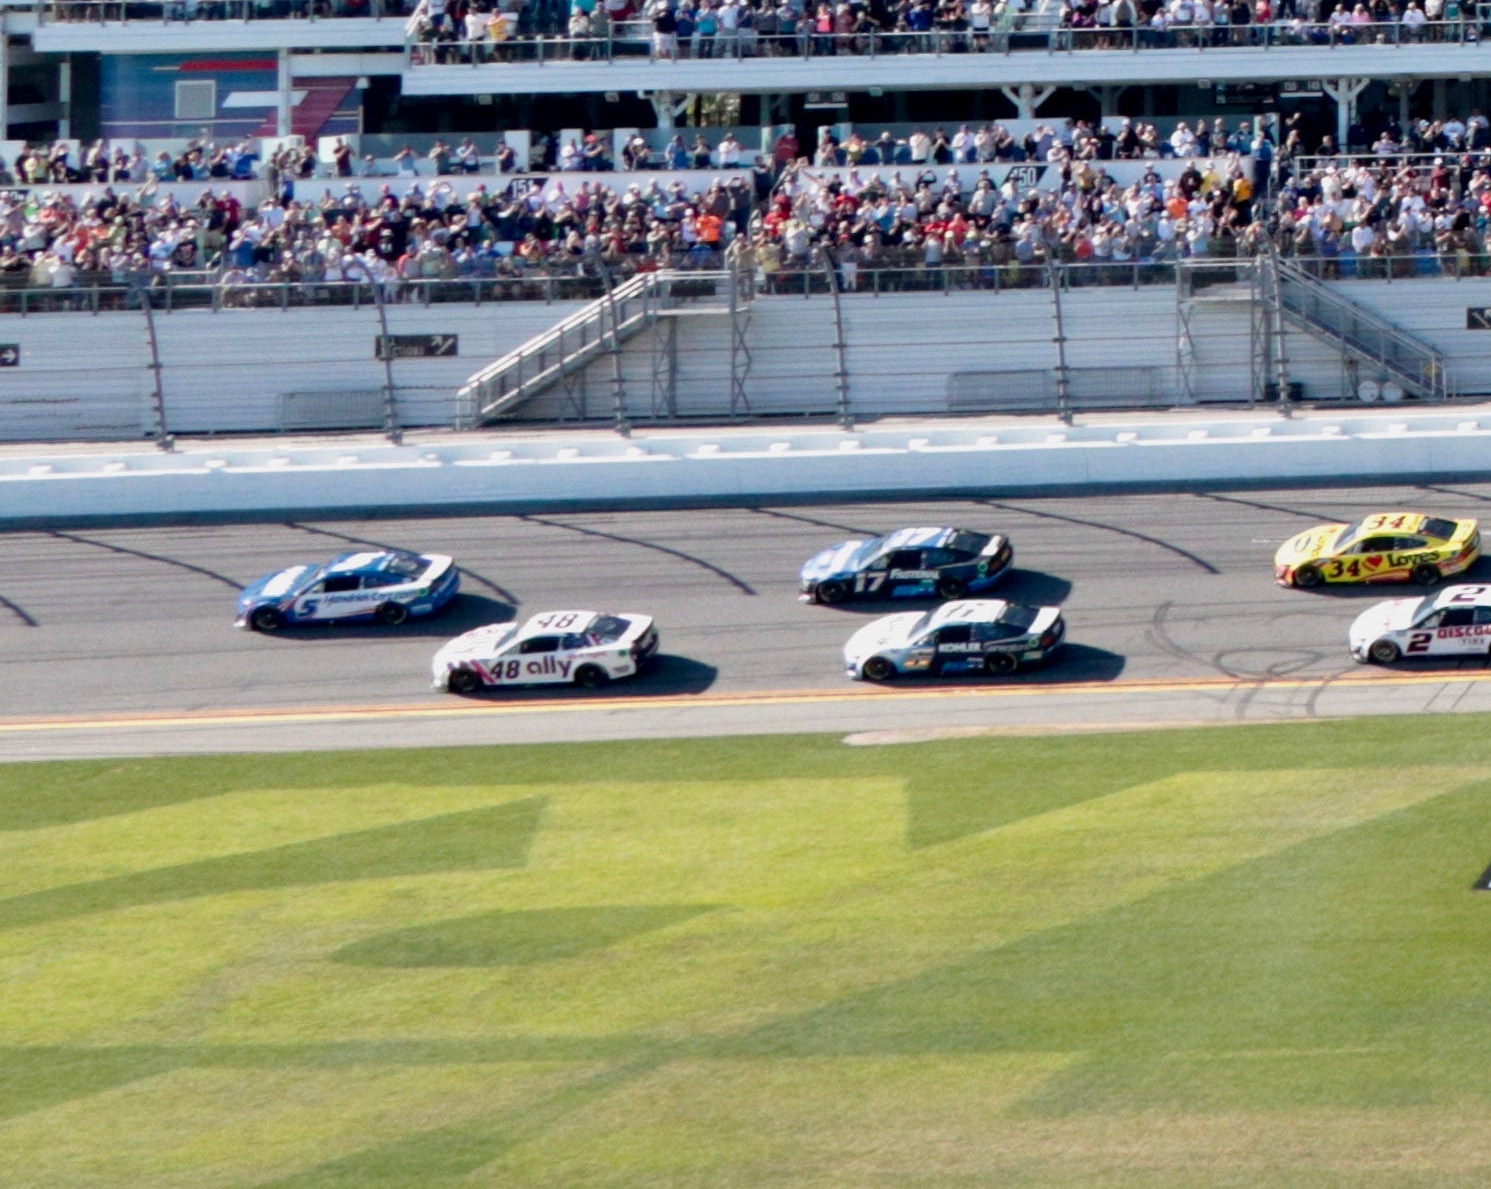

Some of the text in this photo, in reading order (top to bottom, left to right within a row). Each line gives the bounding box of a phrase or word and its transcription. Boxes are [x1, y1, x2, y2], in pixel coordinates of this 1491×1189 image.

[1368, 515, 1407, 530] 34
[1327, 560, 1361, 579] 34
[853, 572, 888, 593] 17
[1449, 587, 1487, 603] 2
[296, 599, 321, 617] 5
[537, 614, 579, 629] 48
[937, 642, 983, 654] KOHLER
[1406, 633, 1433, 653] 2
[490, 654, 572, 681] 48 ally
